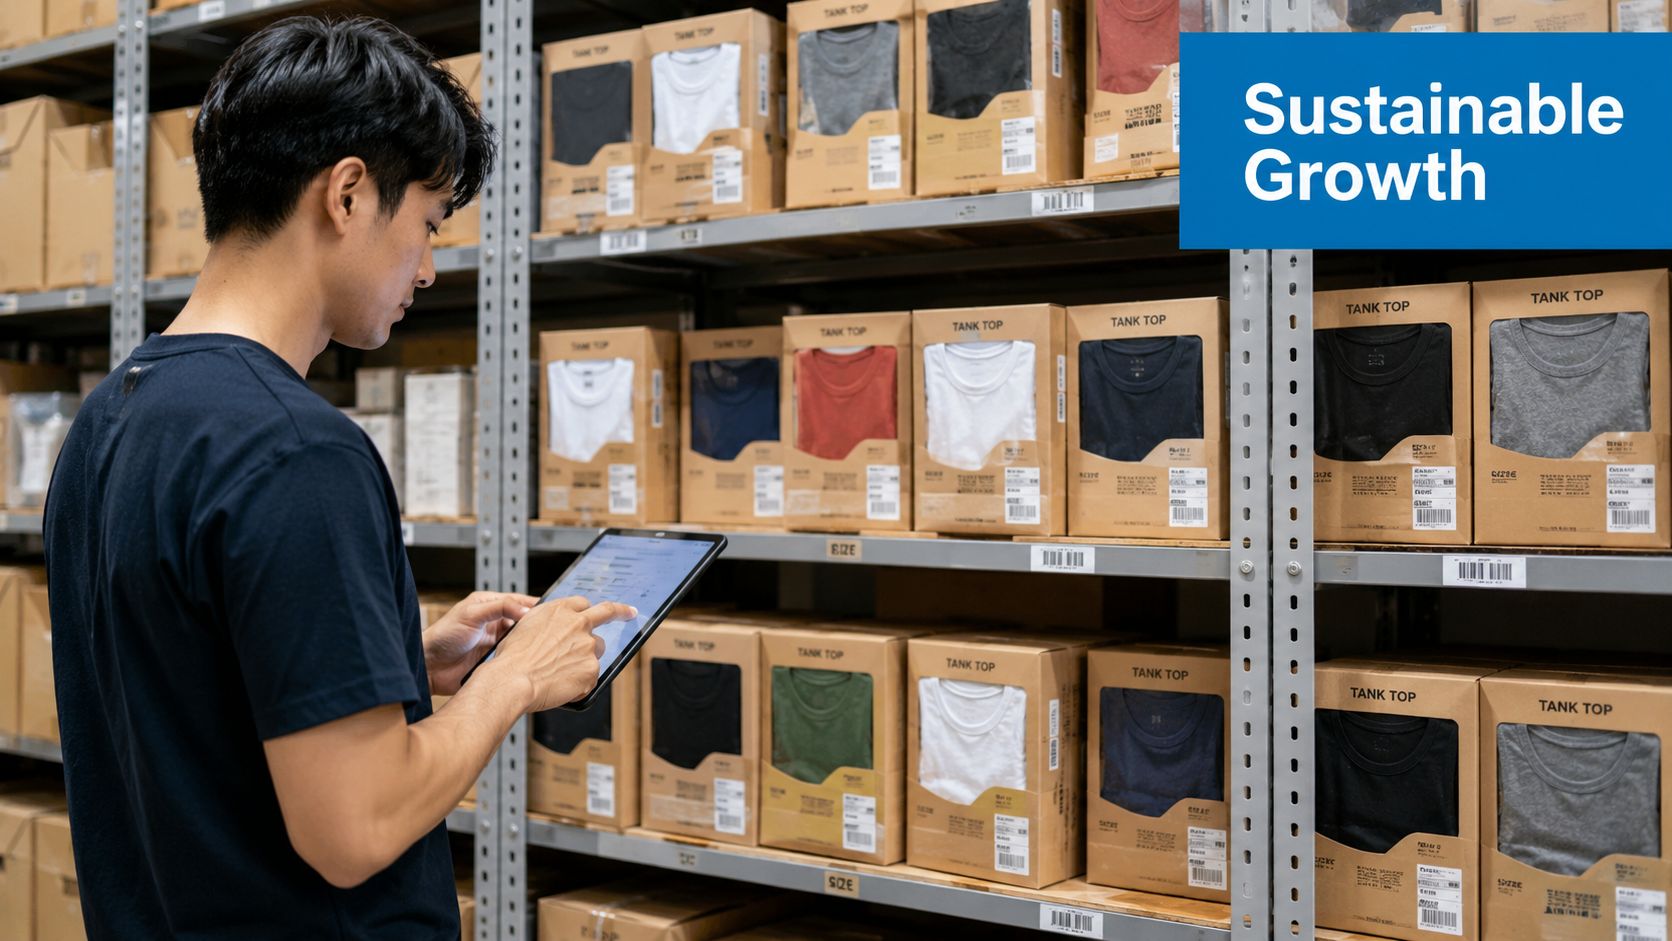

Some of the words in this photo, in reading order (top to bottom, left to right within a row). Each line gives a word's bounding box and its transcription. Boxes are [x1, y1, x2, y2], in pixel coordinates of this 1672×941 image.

[824, 7, 847, 18] TANK
[850, 4, 869, 15] TOP
[698, 28, 715, 37] TOP
[594, 46, 610, 55] TOP
[1531, 291, 1570, 304] TANK
[1573, 289, 1604, 302] TOP
[1346, 303, 1380, 315] TANK
[1383, 301, 1410, 312] TOP
[952, 321, 979, 332] TANK
[982, 320, 1004, 330] TOP
[1110, 316, 1140, 327] TANK
[1143, 314, 1167, 325] TOP
[820, 328, 844, 337] TANK
[847, 327, 867, 336] TOP
[593, 341, 609, 350] TOP
[712, 340, 734, 349] TANK
[736, 339, 755, 348] TOP
[673, 639, 695, 649] TANK
[697, 641, 715, 651] TOP
[797, 647, 822, 658] TANK
[824, 649, 844, 660] TOP
[946, 657, 972, 670] TANK
[975, 661, 996, 672] TOP
[1132, 667, 1162, 679] TANK
[1165, 669, 1189, 680] TOP
[1350, 687, 1386, 701] TANK
[1389, 690, 1416, 702] TOP
[1538, 700, 1578, 714] TANK
[1582, 703, 1613, 716] TOP
